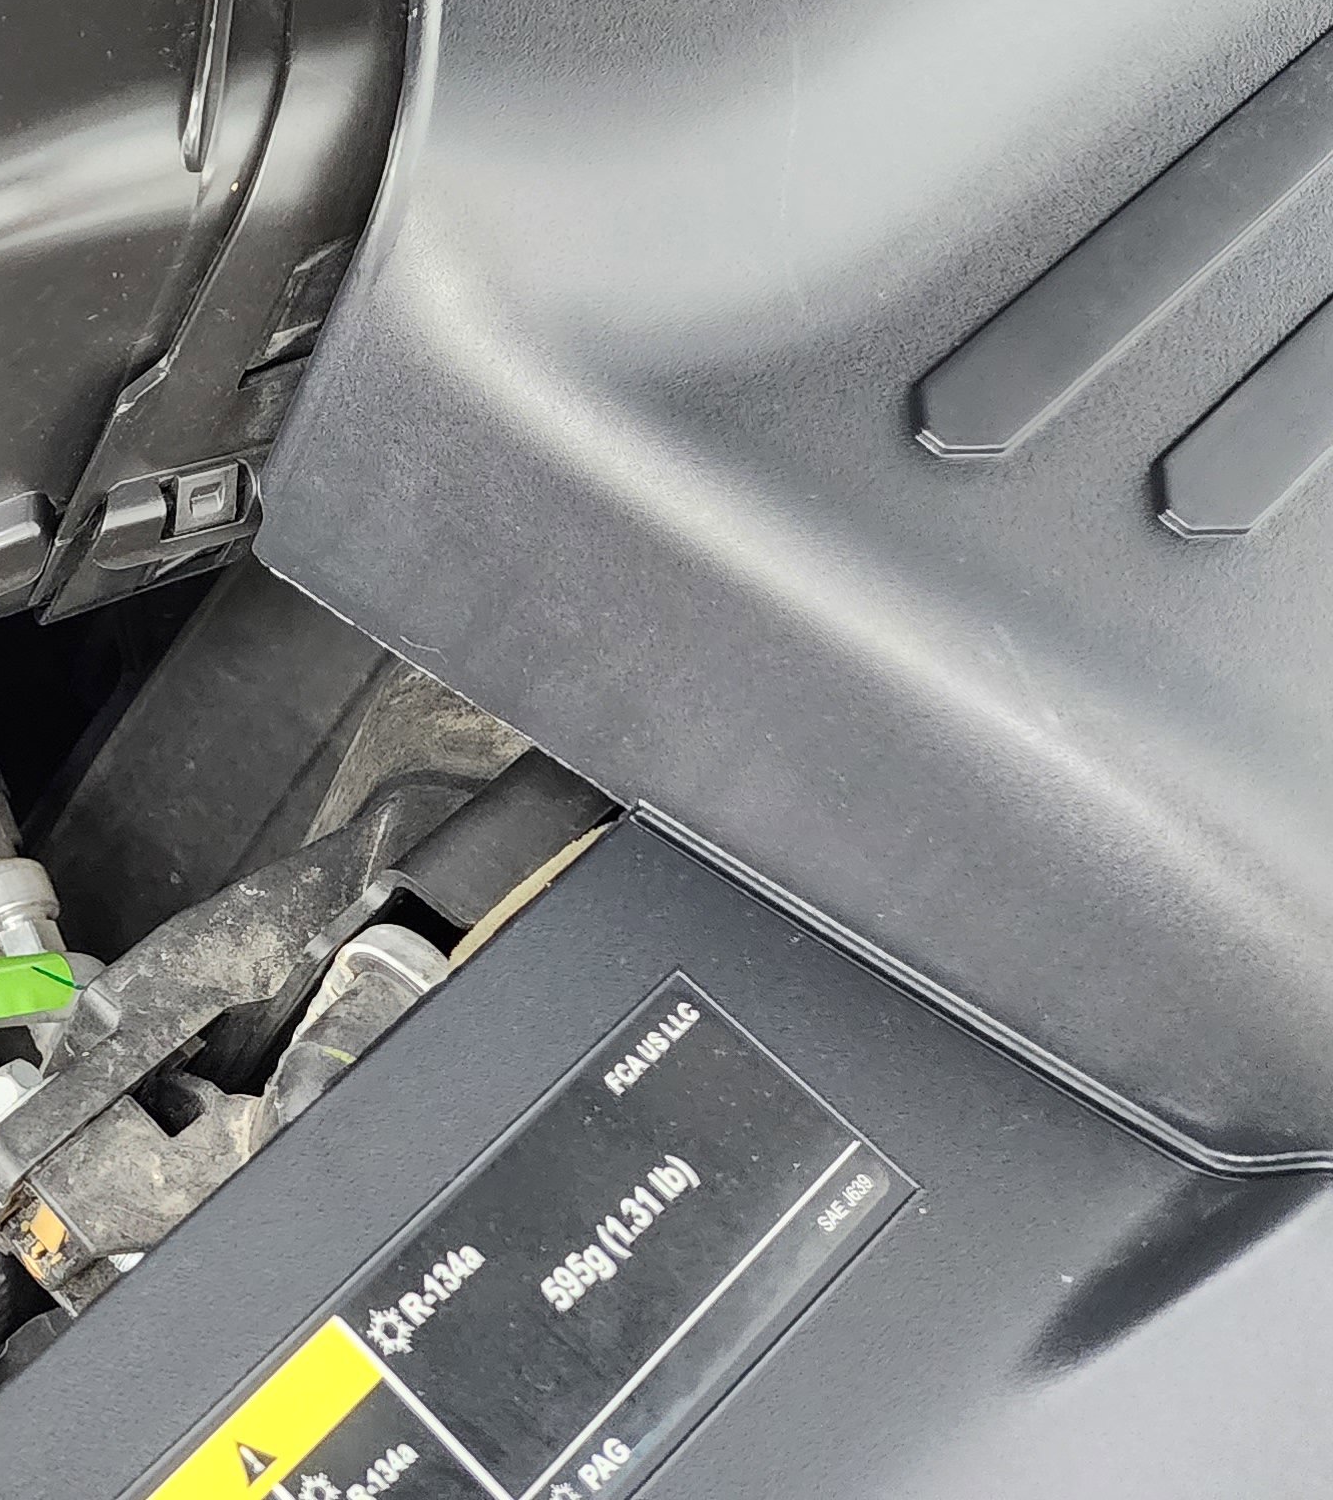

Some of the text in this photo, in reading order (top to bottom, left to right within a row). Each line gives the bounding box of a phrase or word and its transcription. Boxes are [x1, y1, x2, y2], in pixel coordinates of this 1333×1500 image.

[603, 1002, 700, 1096] FCA US LLC
[540, 1154, 701, 1313] 595g (1.31 lb)
[817, 1173, 875, 1233] SAE J639
[398, 1245, 486, 1327] R-134a
[346, 1443, 420, 1500] R-134a
[578, 1437, 633, 1492] PAG
